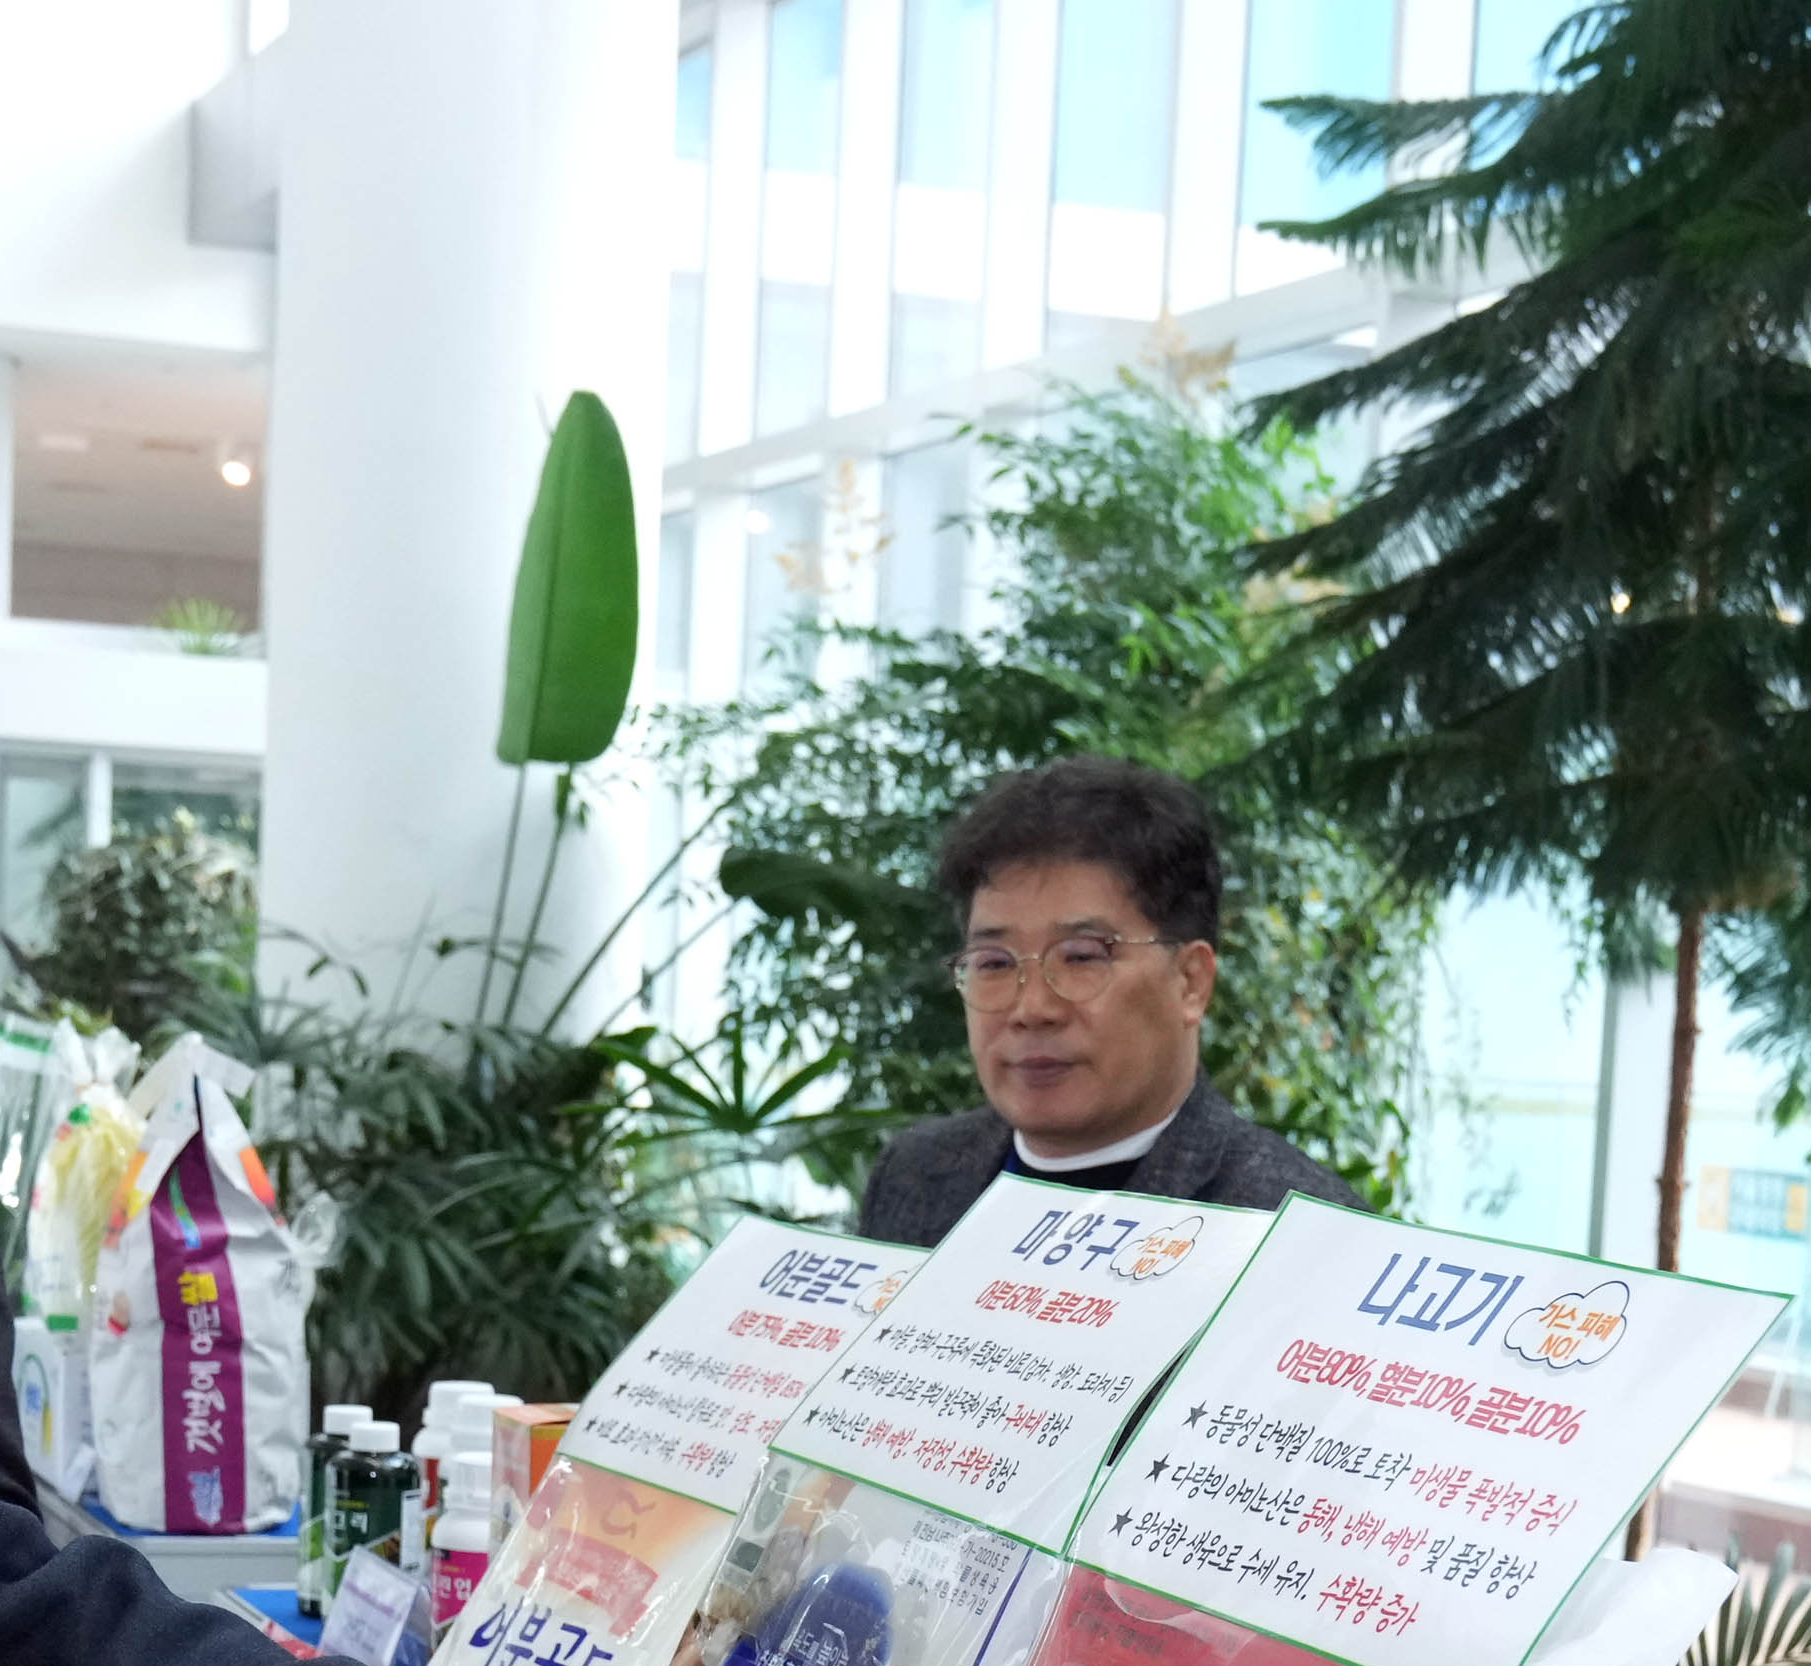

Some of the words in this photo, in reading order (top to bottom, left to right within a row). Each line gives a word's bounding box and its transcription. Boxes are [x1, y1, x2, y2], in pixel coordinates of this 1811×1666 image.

[1012, 1209, 1138, 1270] 마양구
[1137, 1233, 1165, 1254] 가스
[759, 1249, 876, 1304] 어분골드
[1358, 1253, 1522, 1345] 나고기
[1536, 1332, 1581, 1360] NO!
[1538, 1297, 1577, 1330] 가스
[1575, 1311, 1626, 1341] 피해
[818, 1407, 870, 1442] 아미노산은
[984, 1456, 1020, 1494] 향상
[1036, 1411, 1073, 1447] 향상
[1205, 1404, 1263, 1447] 동물성
[1254, 1419, 1315, 1463] 단백질
[1305, 1436, 1371, 1474] 100%로
[1362, 1452, 1412, 1491] 토착
[1408, 1463, 1472, 1508] 미생물
[1464, 1477, 1535, 1525] 폭발적
[1524, 1493, 1578, 1536] 증식
[1170, 1461, 1229, 1499] 다량의
[1224, 1478, 1305, 1526] 아미노산은
[1340, 1510, 1386, 1550] 냉해
[1380, 1525, 1429, 1567] 예방
[1419, 1534, 1455, 1574] 및
[1442, 1542, 1495, 1588] 품질
[1485, 1553, 1537, 1600] 향상
[1130, 1511, 1188, 1558] 왕성한
[1181, 1530, 1243, 1572] 생육으로
[1236, 1547, 1280, 1585] 수세
[1316, 1574, 1383, 1624] 수확량
[1374, 1593, 1419, 1636] 증가
